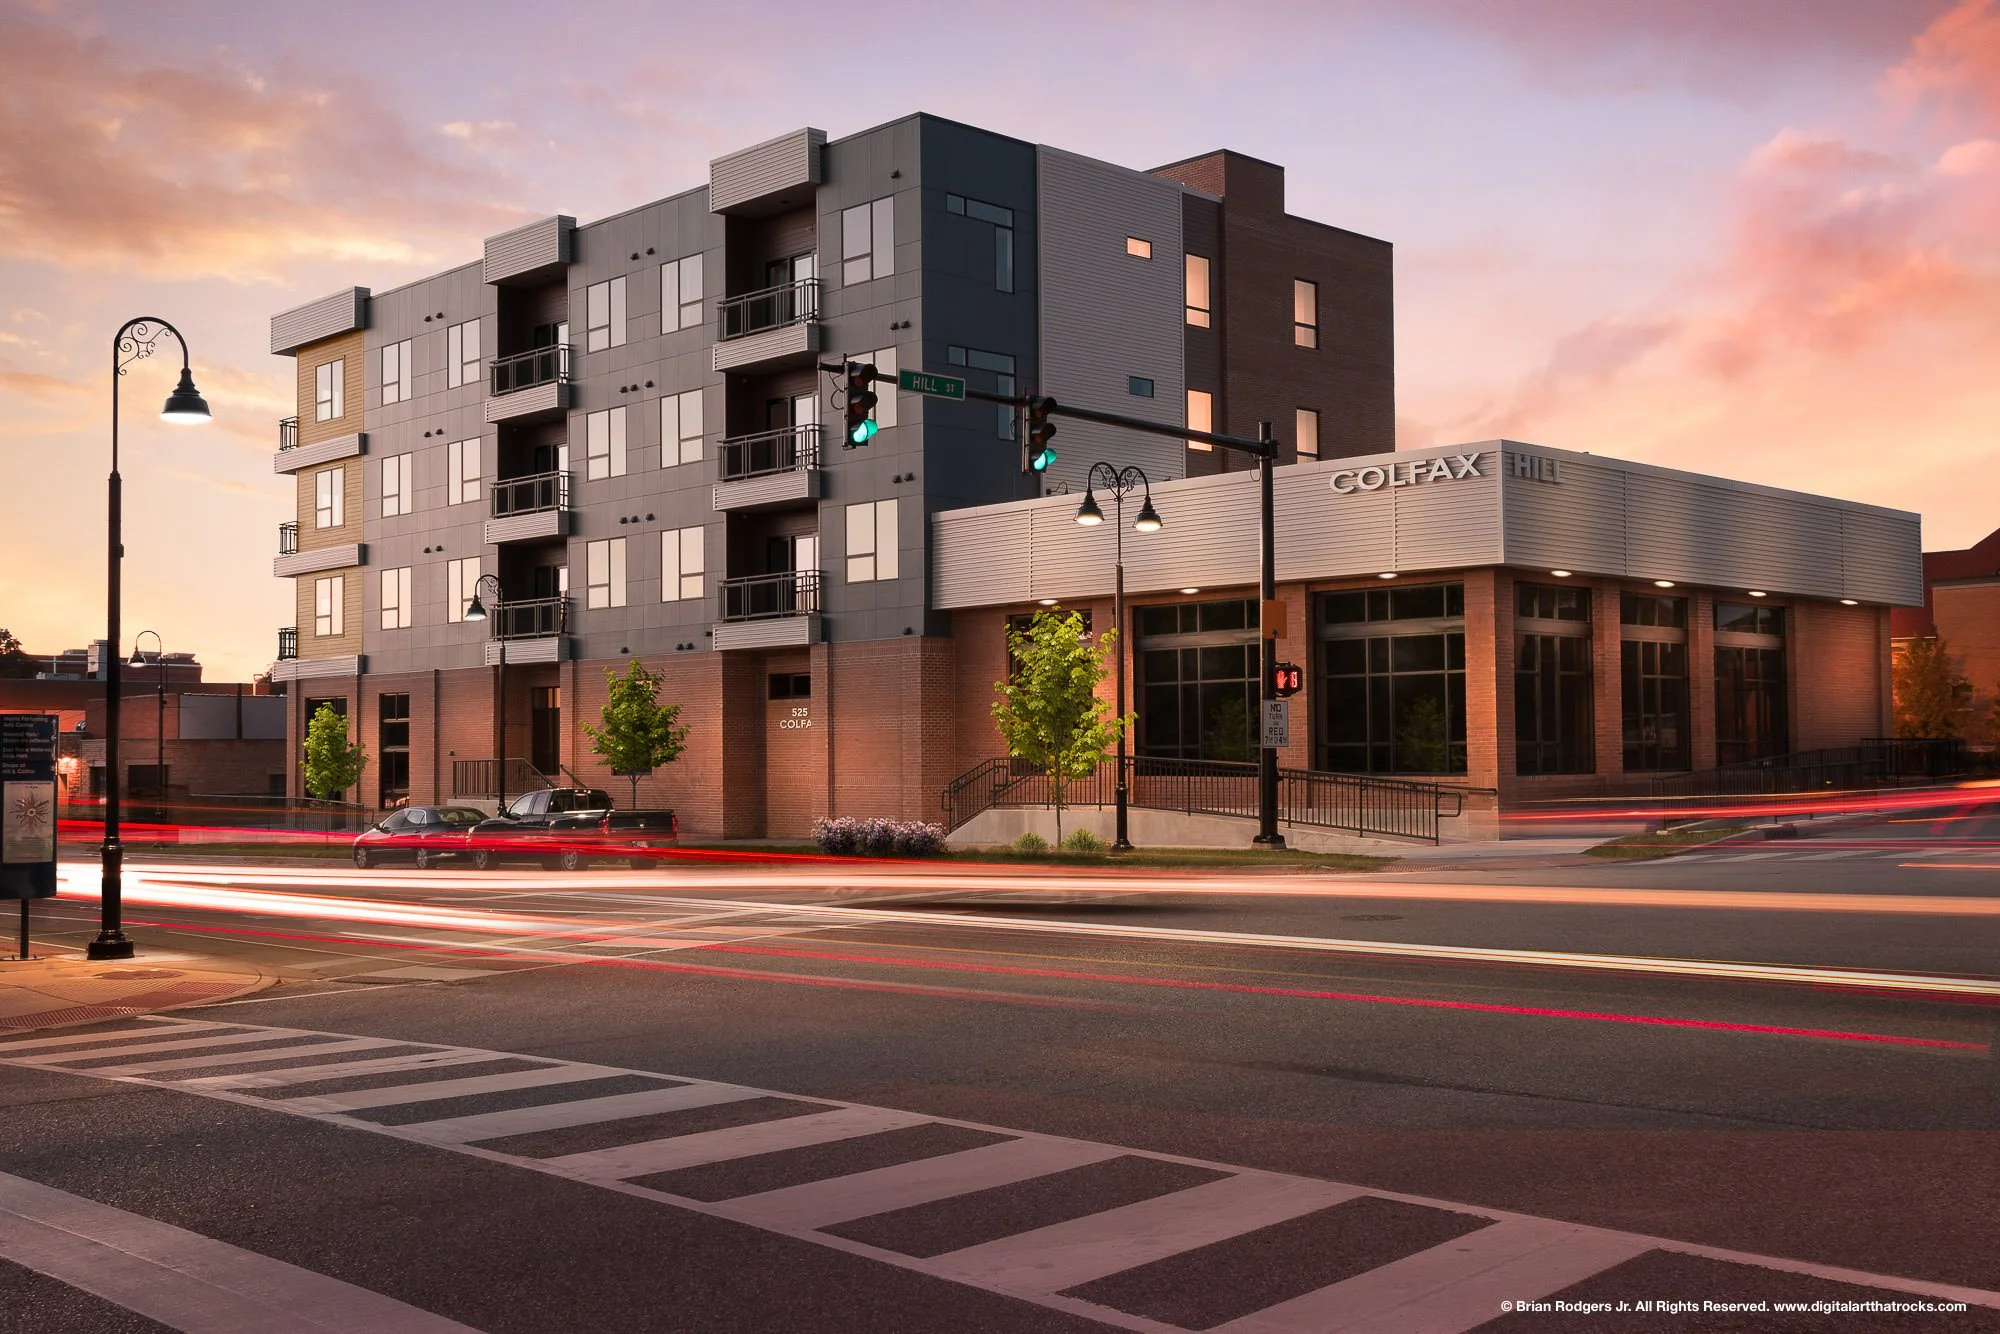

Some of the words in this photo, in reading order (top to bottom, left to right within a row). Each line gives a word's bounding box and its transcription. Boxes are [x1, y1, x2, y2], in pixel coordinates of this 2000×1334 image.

[912, 375, 937, 392] HILL
[945, 383, 955, 393] ST
[1329, 452, 1481, 494] COLFAX
[1513, 452, 1562, 484] HILL
[791, 707, 808, 717] 525
[1270, 703, 1282, 713] NO
[1269, 712, 1283, 720] TURN
[780, 719, 812, 729] COLFA
[1268, 727, 1284, 736] RED
